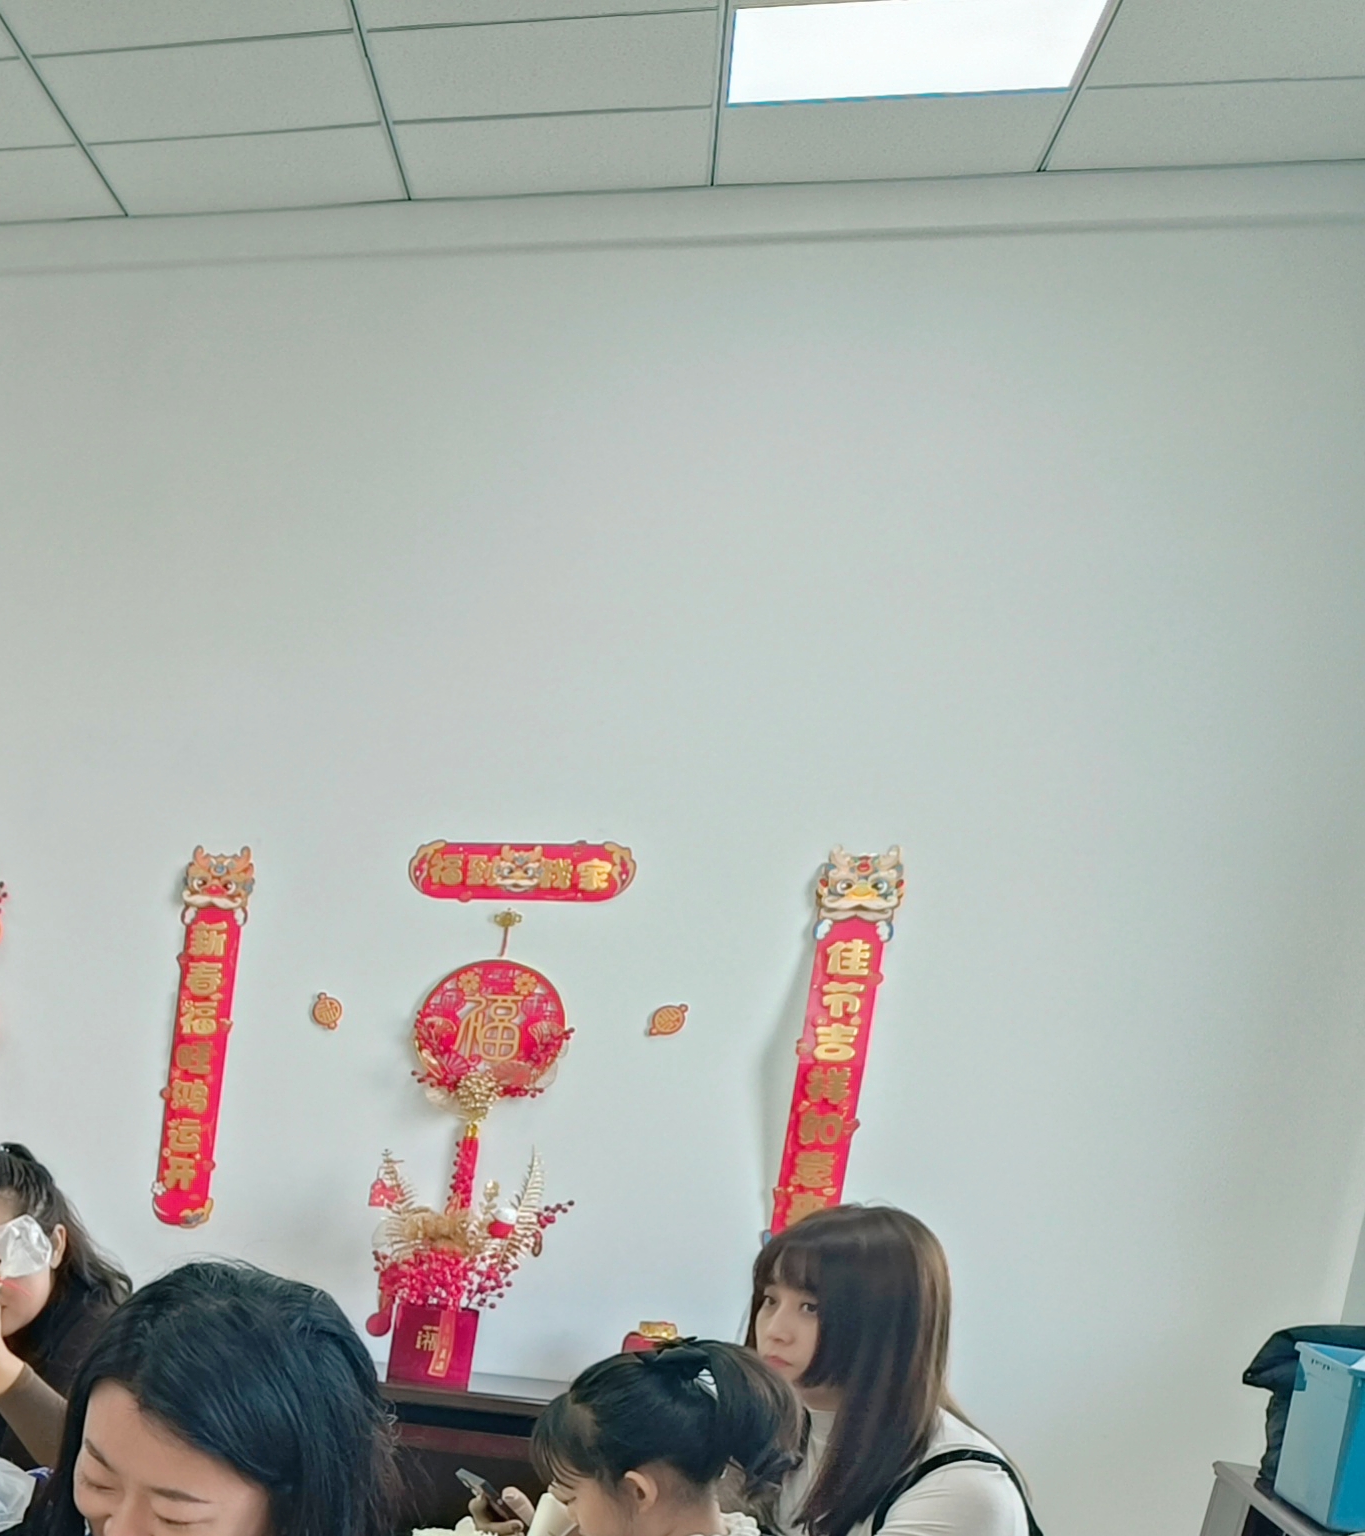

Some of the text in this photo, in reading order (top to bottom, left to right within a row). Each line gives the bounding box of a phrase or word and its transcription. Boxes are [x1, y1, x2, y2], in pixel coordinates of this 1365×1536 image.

[164, 921, 228, 1191] 新春福旺鸿运开
[453, 993, 523, 1061] 福
